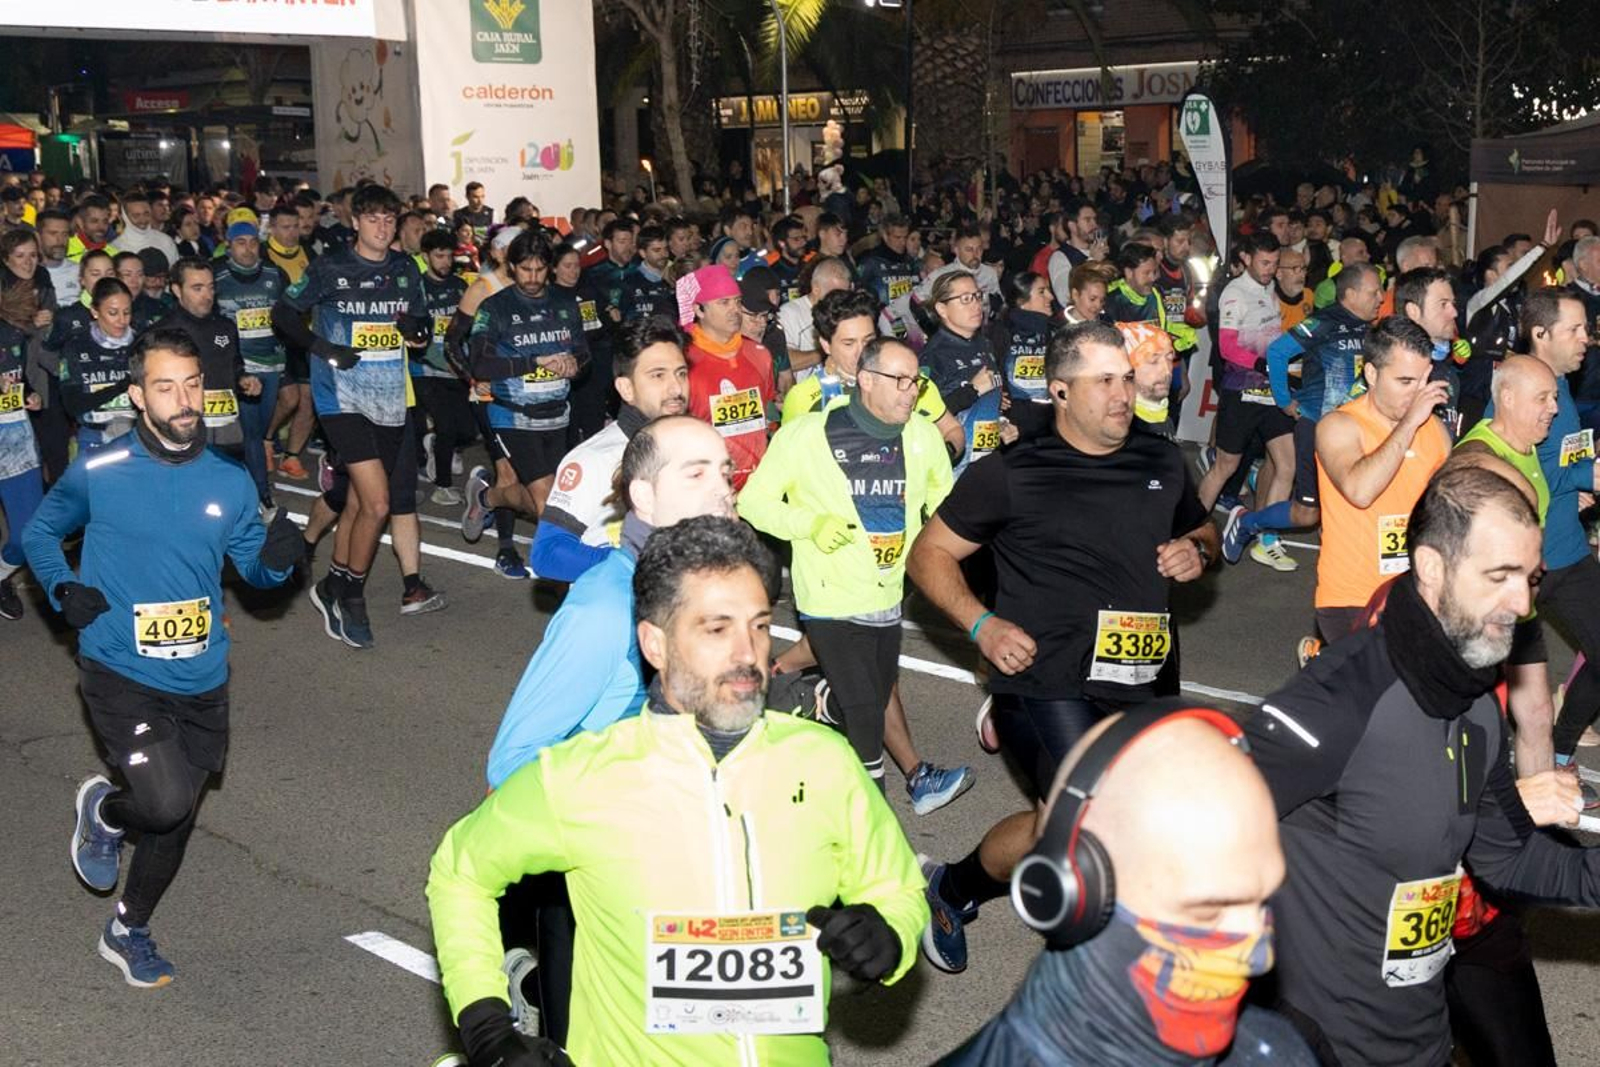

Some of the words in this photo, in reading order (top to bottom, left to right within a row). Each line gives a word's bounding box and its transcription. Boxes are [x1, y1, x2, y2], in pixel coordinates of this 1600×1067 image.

[476, 31, 501, 42] CAJA
[502, 32, 536, 43] RURAL
[462, 83, 555, 100] calderón
[1014, 77, 1124, 105] CONFECCIONS
[336, 301, 365, 315] SAN
[357, 333, 400, 348] 3908
[513, 331, 538, 347] SAN
[1338, 339, 1362, 351] SAN
[1010, 345, 1033, 355] SAN
[82, 371, 106, 384] SAN
[717, 400, 759, 421] 3872
[145, 615, 206, 639] 4029
[1104, 631, 1166, 657] 3382
[688, 918, 717, 938] 42
[1400, 899, 1455, 947] 369
[656, 945, 805, 983] 12083
